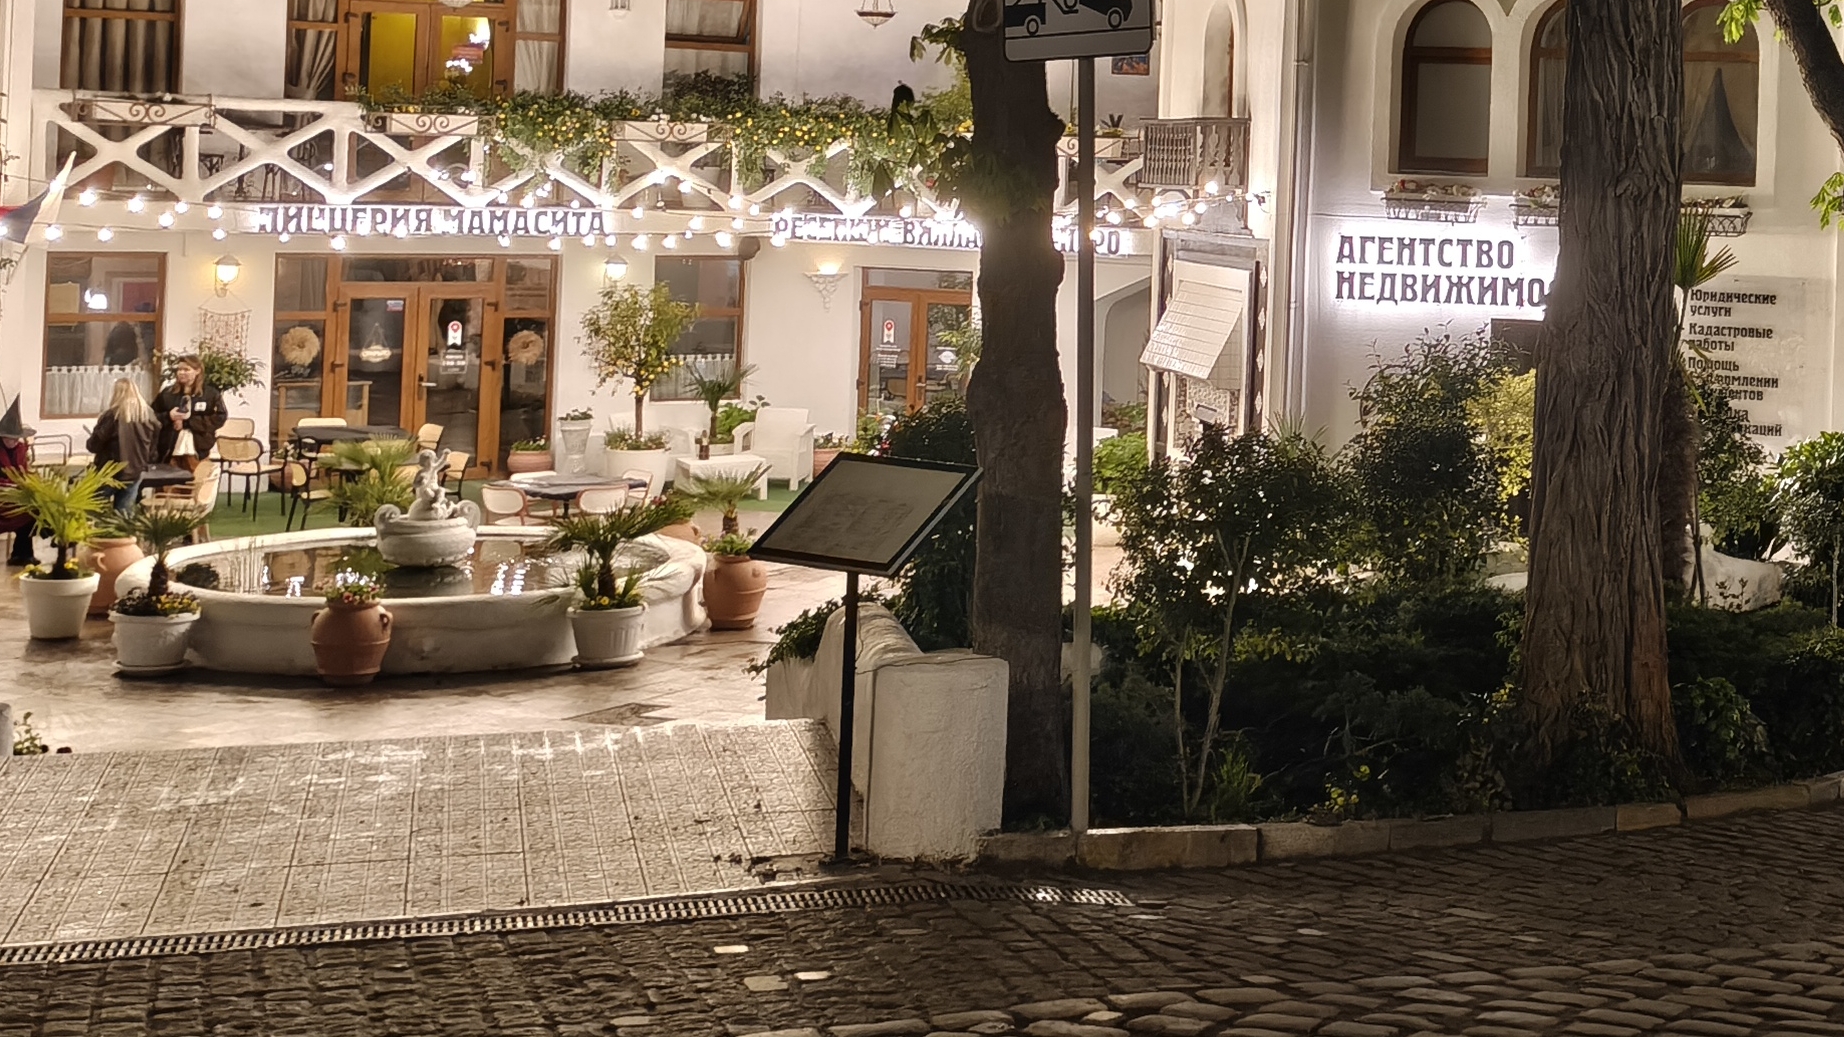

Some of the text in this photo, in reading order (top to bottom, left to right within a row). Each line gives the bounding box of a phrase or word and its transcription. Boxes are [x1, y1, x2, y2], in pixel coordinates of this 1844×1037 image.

[1336, 235, 1514, 268] АГЕНТСТВО
[1690, 289, 1777, 305] Юридические
[1690, 305, 1732, 317] услуги
[1689, 323, 1773, 339] Кадастровые
